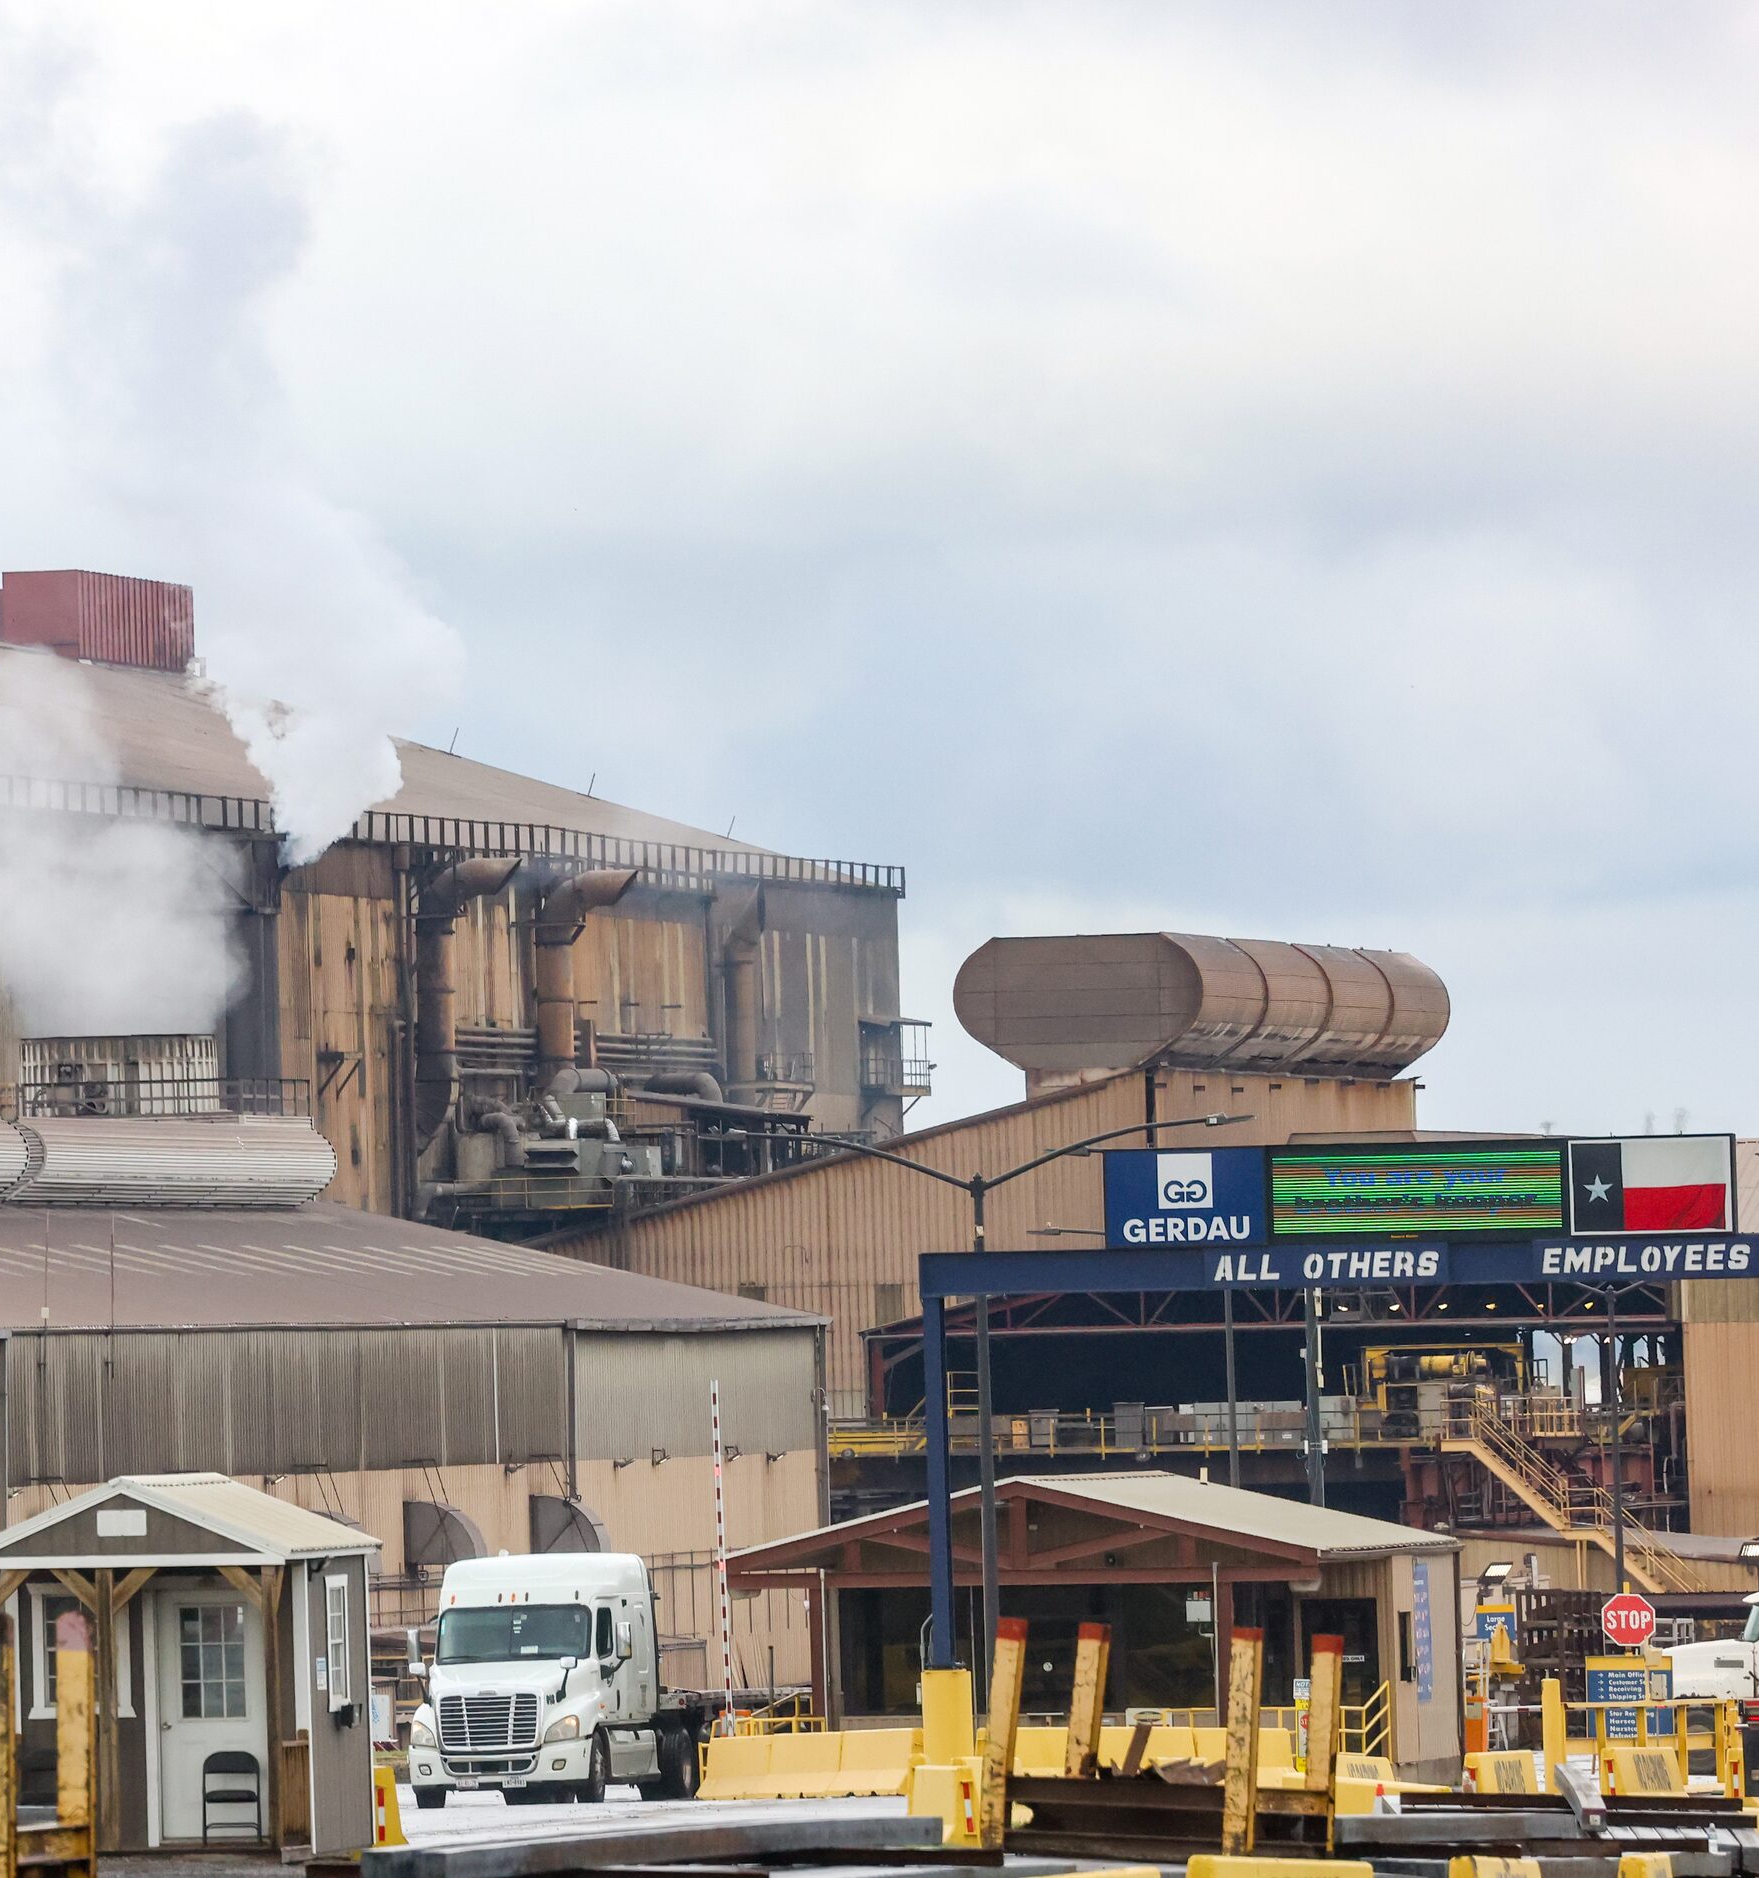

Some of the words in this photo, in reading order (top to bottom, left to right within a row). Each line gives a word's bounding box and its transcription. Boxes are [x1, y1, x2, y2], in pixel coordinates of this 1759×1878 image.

[1322, 1168, 1375, 1186] You
[1385, 1170, 1433, 1186] are
[1442, 1168, 1507, 1190] your
[1123, 1216, 1250, 1243] GERDAU
[1214, 1254, 1280, 1281] ALL
[1304, 1250, 1440, 1279] OTHERS
[1542, 1243, 1751, 1275] EMPLOYEES
[1486, 1615, 1506, 1623] Large
[1606, 1610, 1652, 1630] STOP
